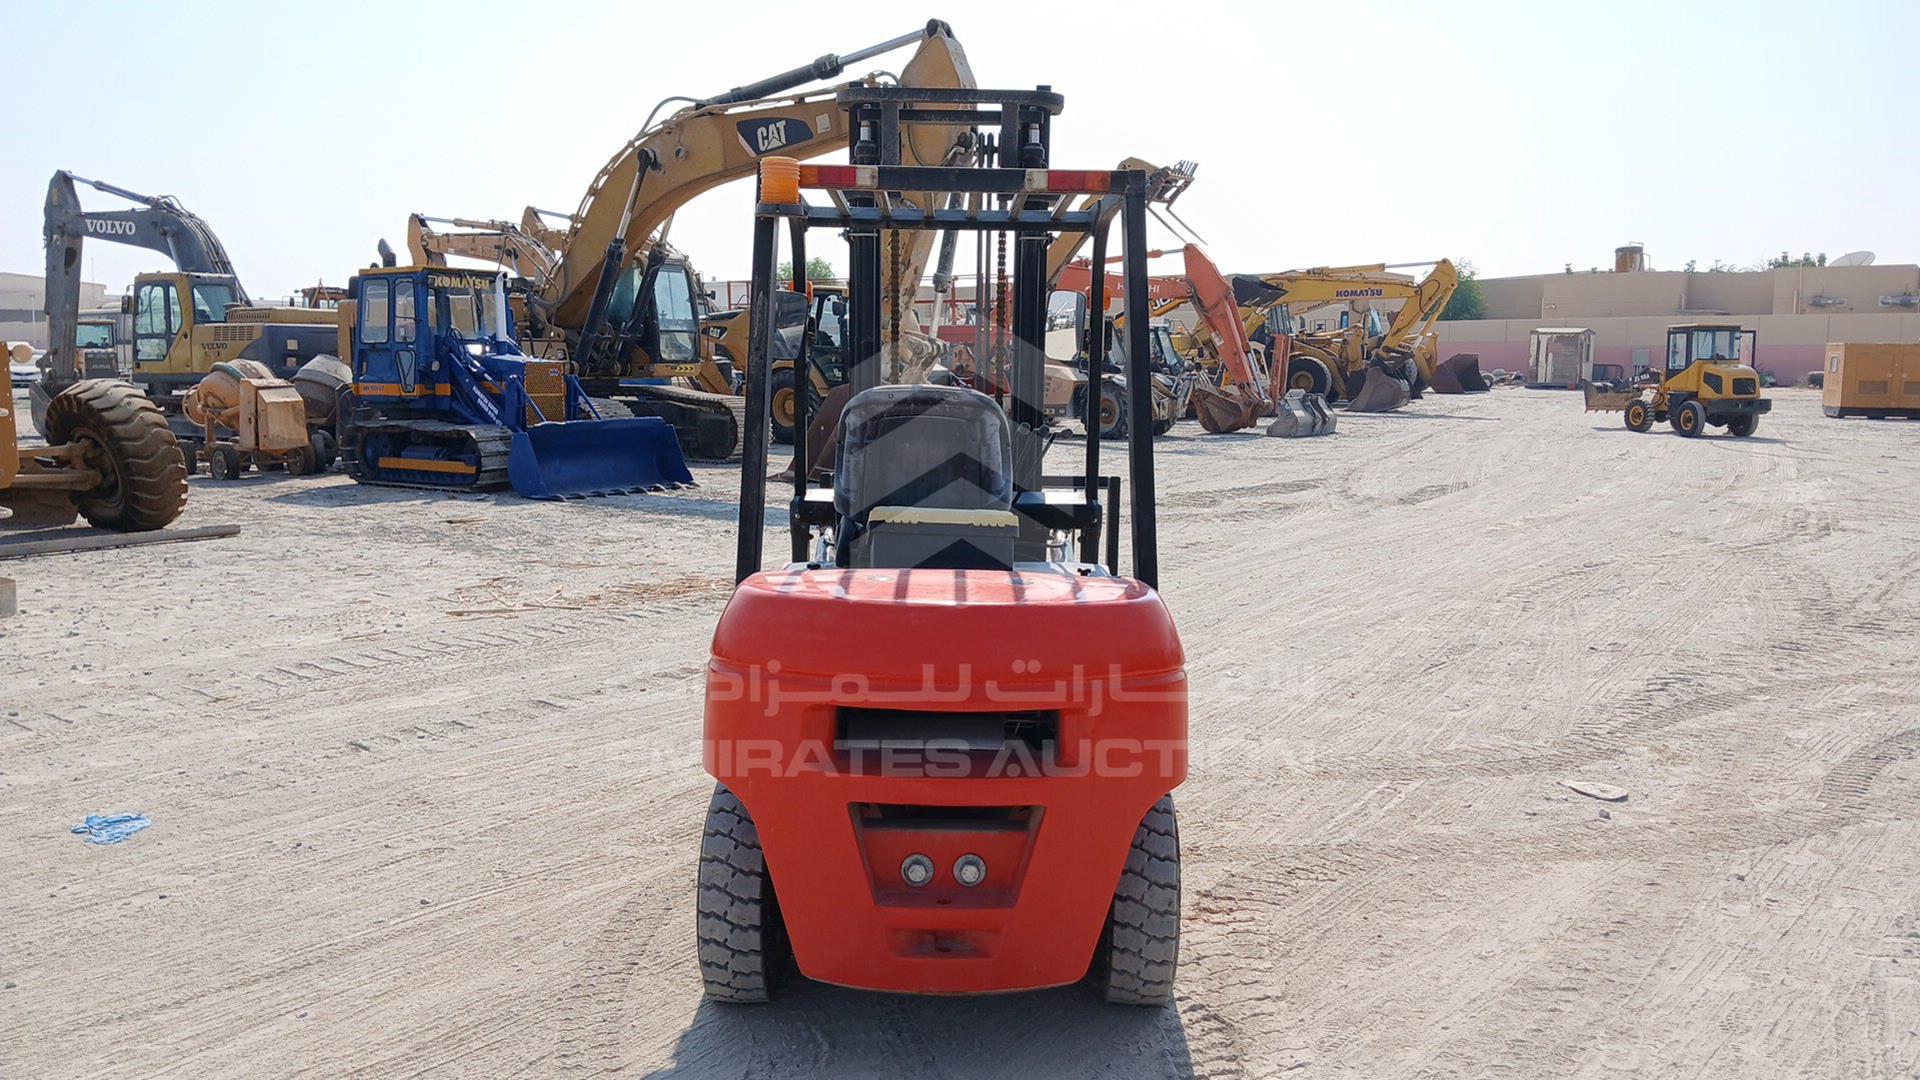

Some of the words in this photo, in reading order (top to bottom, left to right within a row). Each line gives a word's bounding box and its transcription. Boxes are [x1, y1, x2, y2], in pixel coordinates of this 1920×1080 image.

[756, 120, 787, 151] CAT
[84, 218, 136, 236] VOLVO
[1335, 287, 1383, 298] KOMATSU
[709, 326, 721, 338] CAT
[201, 342, 228, 350] VOLVO
